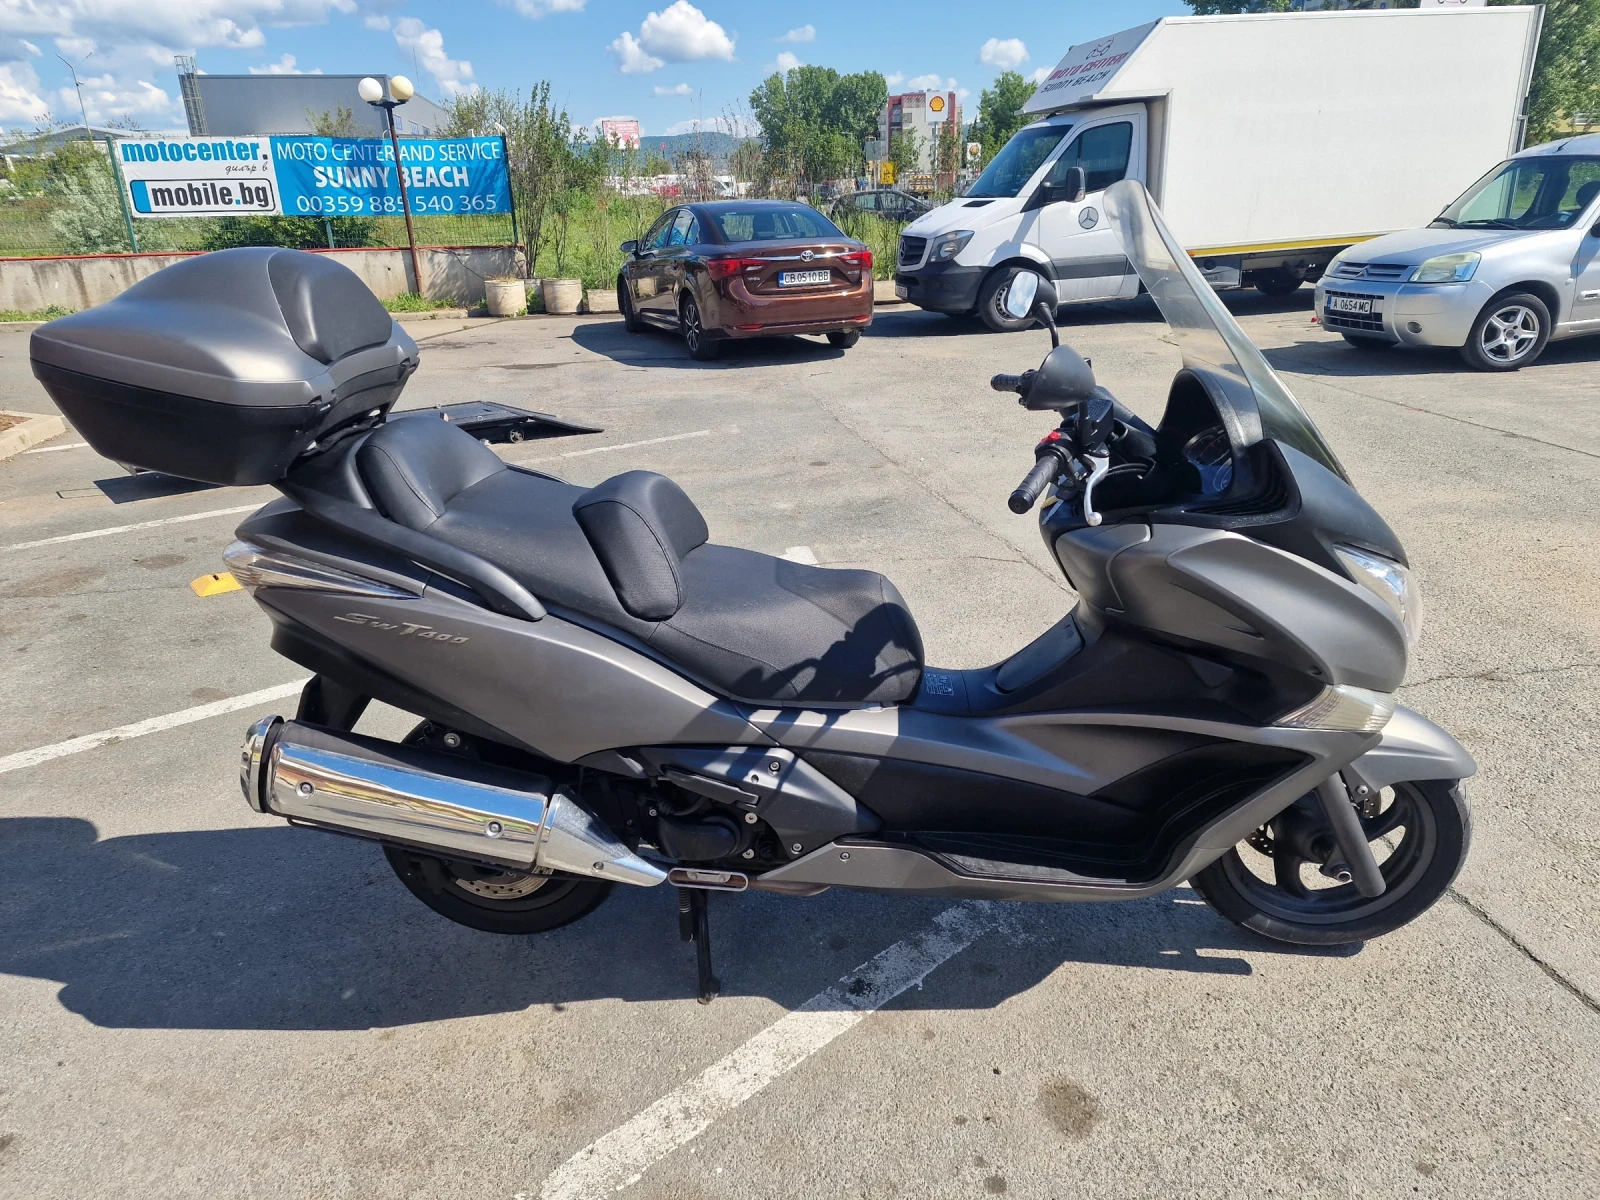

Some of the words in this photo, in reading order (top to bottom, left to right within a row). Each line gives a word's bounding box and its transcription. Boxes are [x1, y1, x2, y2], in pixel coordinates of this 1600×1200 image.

[1048, 64, 1083, 81] MOTO
[1080, 51, 1129, 74] CENTER
[1041, 78, 1075, 93] SUNNY
[1072, 69, 1111, 87] BEACH
[276, 142, 327, 160] MOTO
[332, 143, 395, 161] CENTER
[399, 145, 435, 161] AND
[439, 142, 501, 161] SERVICE
[313, 166, 390, 188] SUNNY
[151, 182, 270, 208] mobile.bg
[296, 195, 363, 212] 00359
[415, 195, 454, 212] 540
[460, 194, 496, 211] 365
